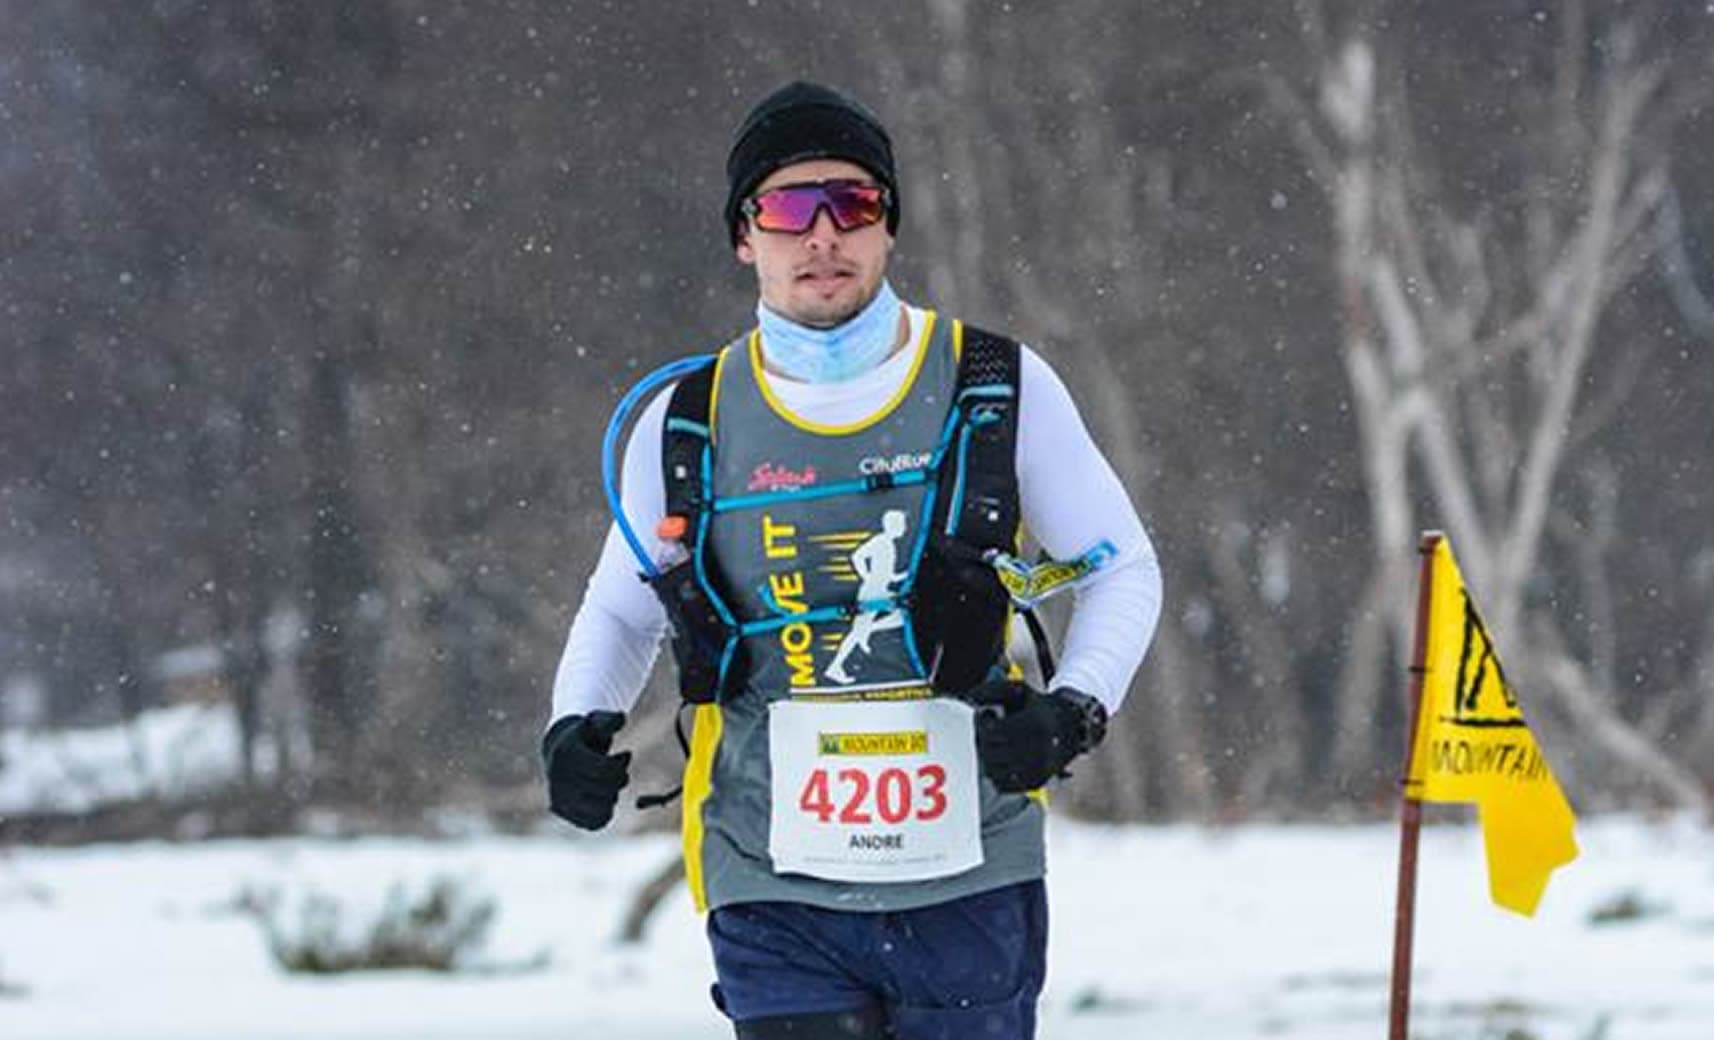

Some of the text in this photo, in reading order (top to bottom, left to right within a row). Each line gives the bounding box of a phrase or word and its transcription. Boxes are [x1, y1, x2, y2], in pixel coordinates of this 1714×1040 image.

[763, 515, 797, 558] IT
[799, 765, 947, 823] 4203
[850, 834, 904, 849] ANDRE
